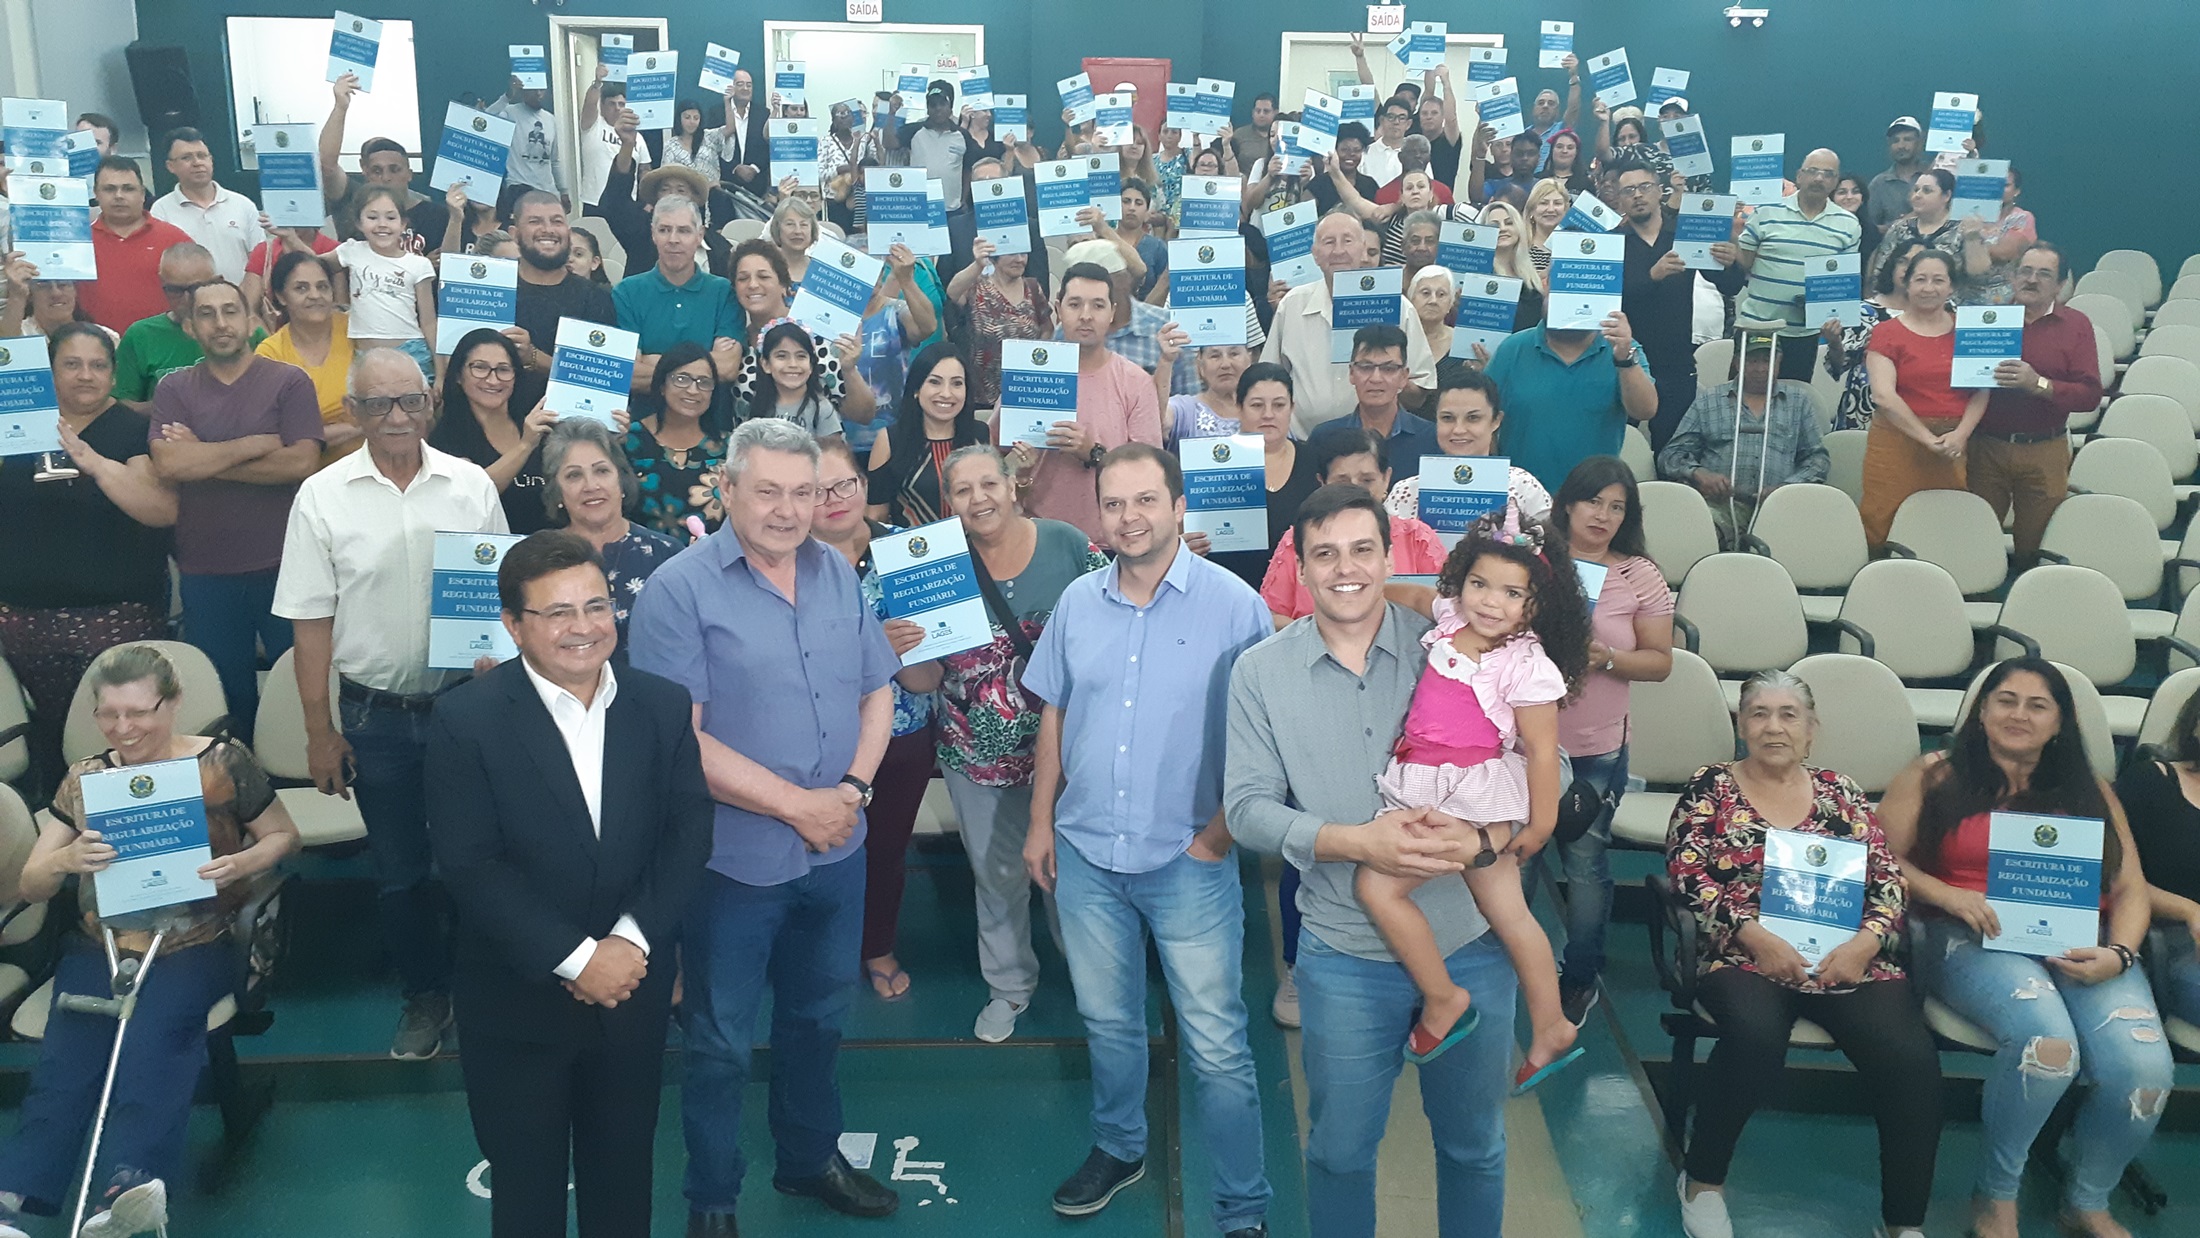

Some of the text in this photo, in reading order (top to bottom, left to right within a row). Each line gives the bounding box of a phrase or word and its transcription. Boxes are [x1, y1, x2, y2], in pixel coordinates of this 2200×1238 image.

[849, 1, 879, 16] SAÍDA
[1370, 12, 1400, 26] SAÍDA
[937, 58, 958, 68] SAÍDA
[1561, 262, 1601, 271] ESCRITURA
[817, 265, 863, 292] ESCRITURA DE
[1180, 273, 1234, 282] ESCRITURA DE
[450, 286, 504, 299] ESCRITURA DE
[1177, 283, 1238, 293] REGULARIZAÇÃO
[446, 297, 508, 309] REGULARIZAÇÃO
[1187, 294, 1228, 303] FUNDIÁRIA
[455, 307, 497, 317] FUNDIÁRIA
[565, 351, 622, 369] ESCRITURA DE
[559, 361, 624, 379] REGULARIZAÇÃO
[568, 372, 611, 387] FUNDIÁRIA
[1012, 375, 1054, 384] ESCRITURA
[1008, 385, 1070, 396] REGULARIZAÇÃO
[1018, 396, 1059, 406] FUNDIÁRIA
[1193, 473, 1252, 483] ESCRITURA DE
[1190, 483, 1257, 496] REGULARIZAÇÃO
[1201, 495, 1245, 506] FUNDIÁRIA
[1431, 495, 1494, 505] ESCRITURA DE
[1425, 507, 1490, 517] REGULARIZAÇ
[894, 561, 958, 585] ESCRITURA DE
[449, 577, 498, 587] ESCRITUR
[892, 573, 967, 600] REGULARIZAÇÃO
[442, 590, 500, 600] REGULARIZ
[908, 590, 957, 609] FUNDIÁRIA
[456, 604, 500, 613] FUNDIÁR
[931, 629, 953, 640] LAGES
[105, 807, 186, 828] ESCRITURA DE
[102, 818, 194, 843] REGULARIZAÇÃO
[118, 837, 181, 855] FUNDIÁRIA
[2005, 858, 2083, 875] ESCRITURA DE
[1998, 870, 2089, 888] REGULARIZAÇÃO
[2012, 886, 2073, 901] FUNDIÁRIA
